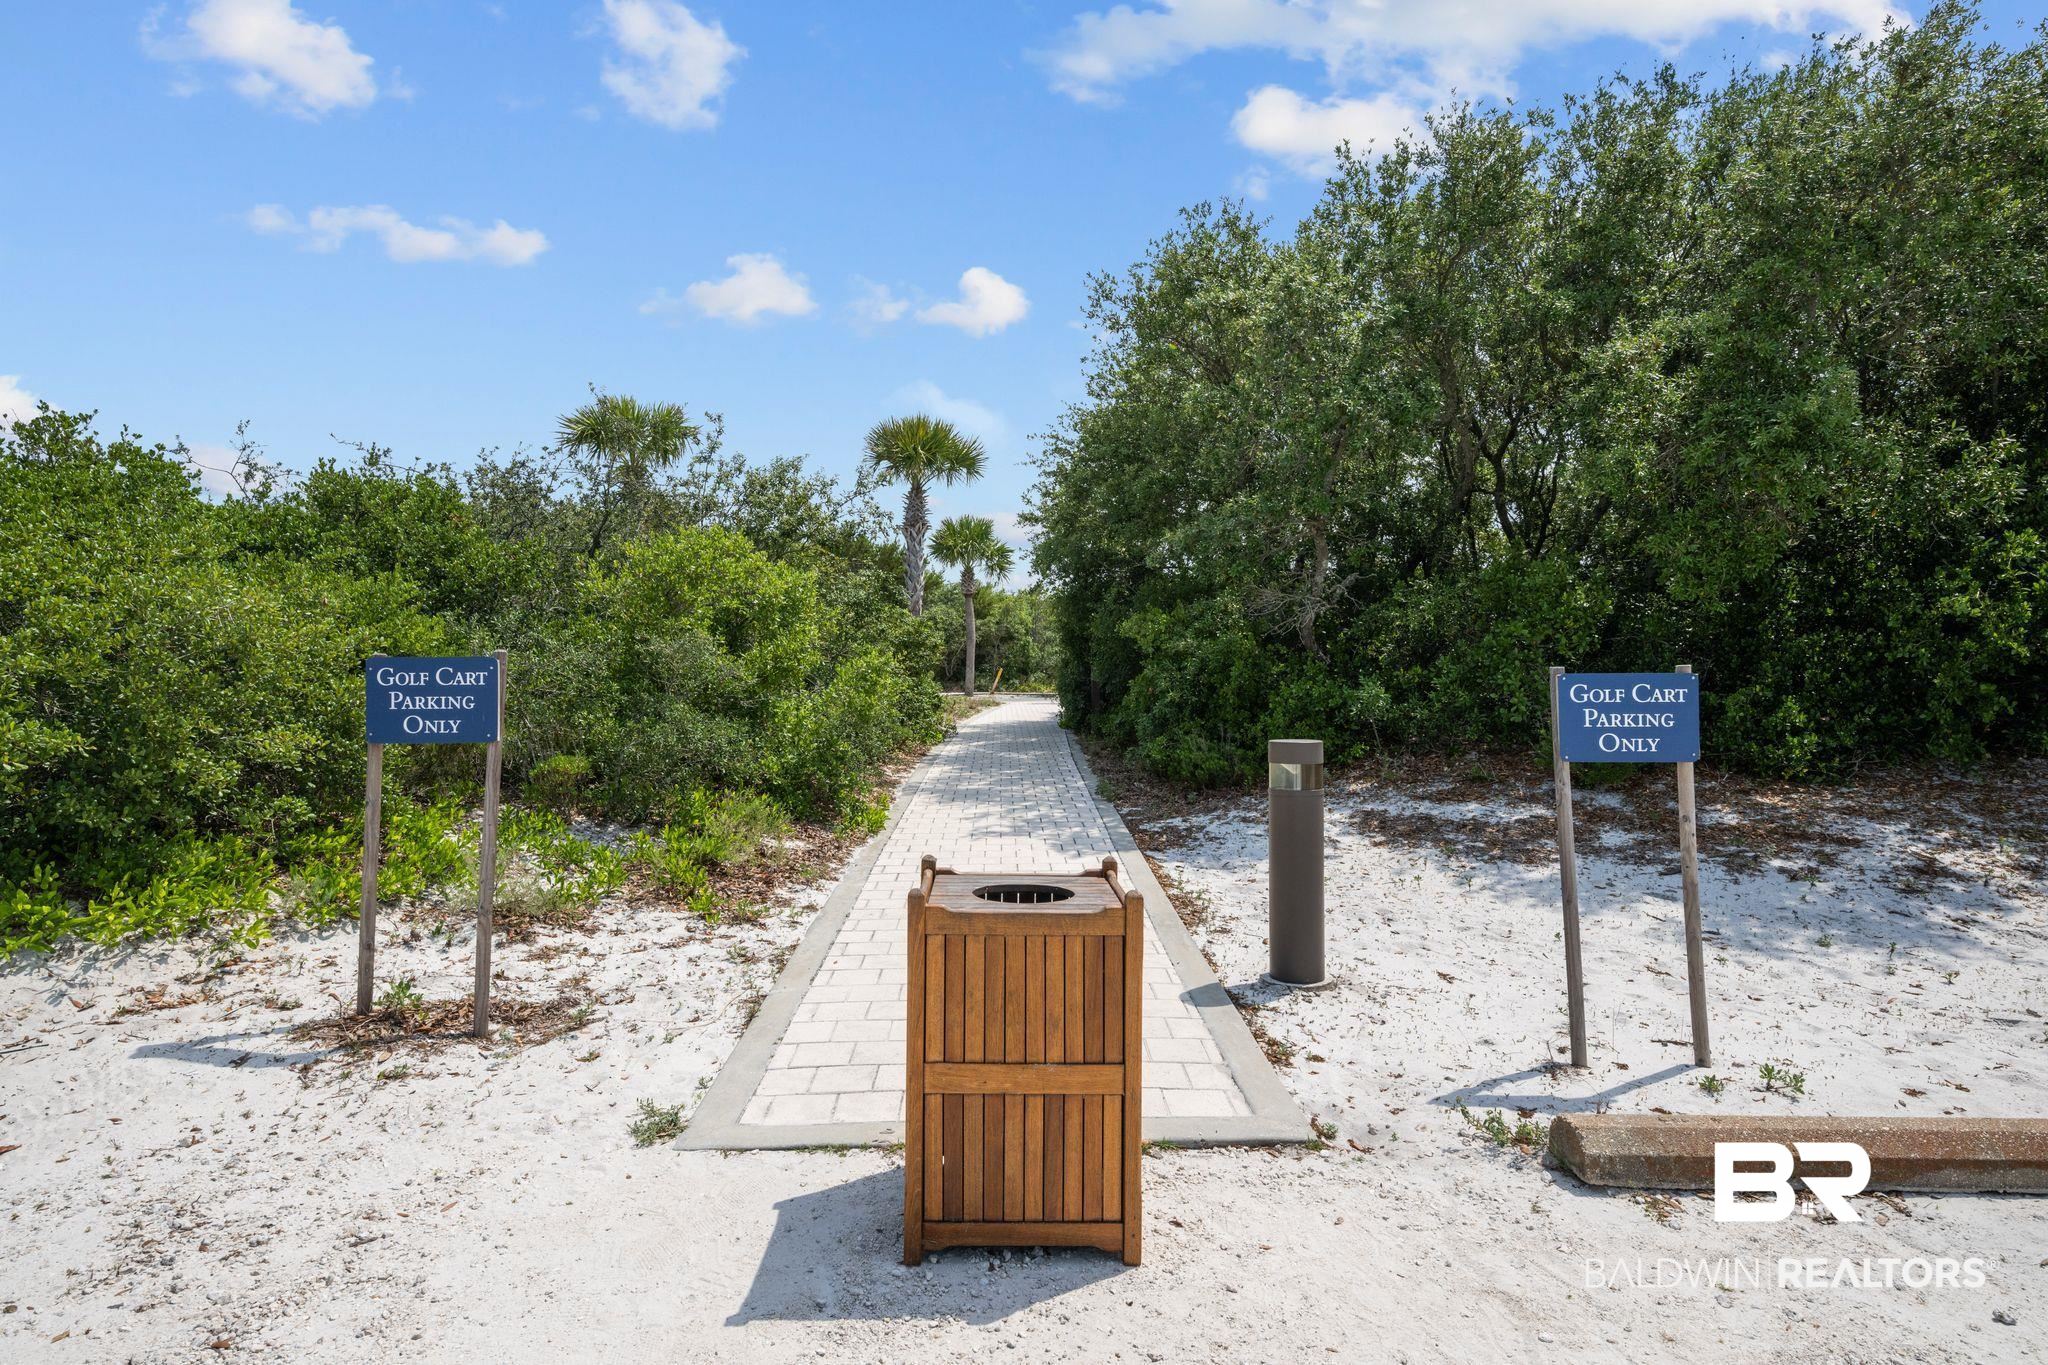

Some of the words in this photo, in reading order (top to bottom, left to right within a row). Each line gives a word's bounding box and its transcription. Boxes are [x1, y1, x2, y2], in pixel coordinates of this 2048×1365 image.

[376, 667, 429, 687] GOLF
[435, 666, 488, 686] CART
[388, 691, 476, 710] PARKING
[1569, 683, 1625, 703] GOLF
[1631, 683, 1688, 703] CART
[403, 715, 461, 734] ONLY
[1583, 708, 1675, 728] PARKING
[1598, 732, 1661, 753] ONLY
